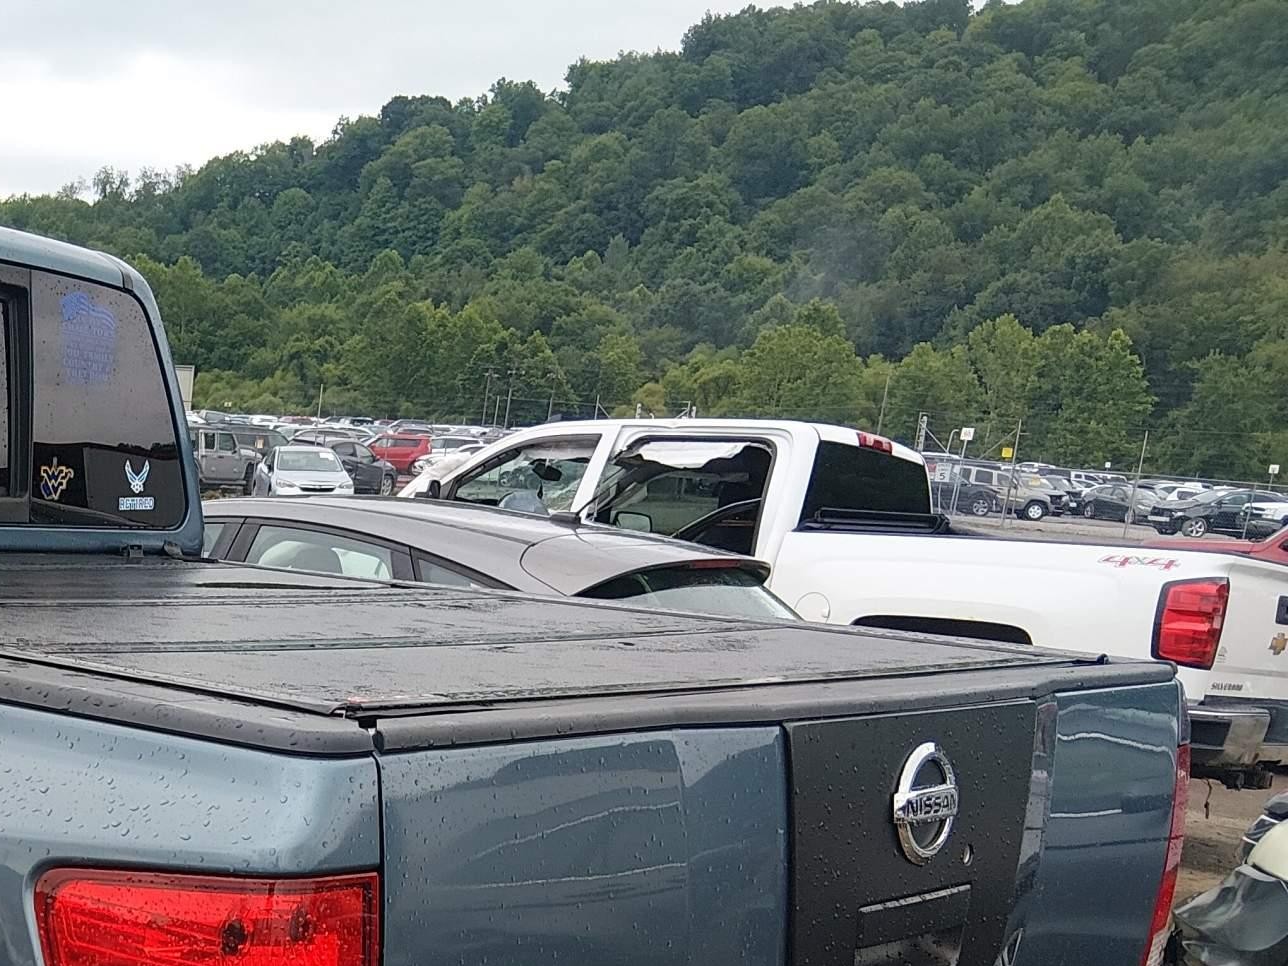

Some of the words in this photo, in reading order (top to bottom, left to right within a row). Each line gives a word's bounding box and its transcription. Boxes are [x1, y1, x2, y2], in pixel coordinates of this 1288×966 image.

[939, 472, 946, 481] 5
[119, 497, 154, 510] RETIRED
[905, 792, 958, 817] NISSAN
